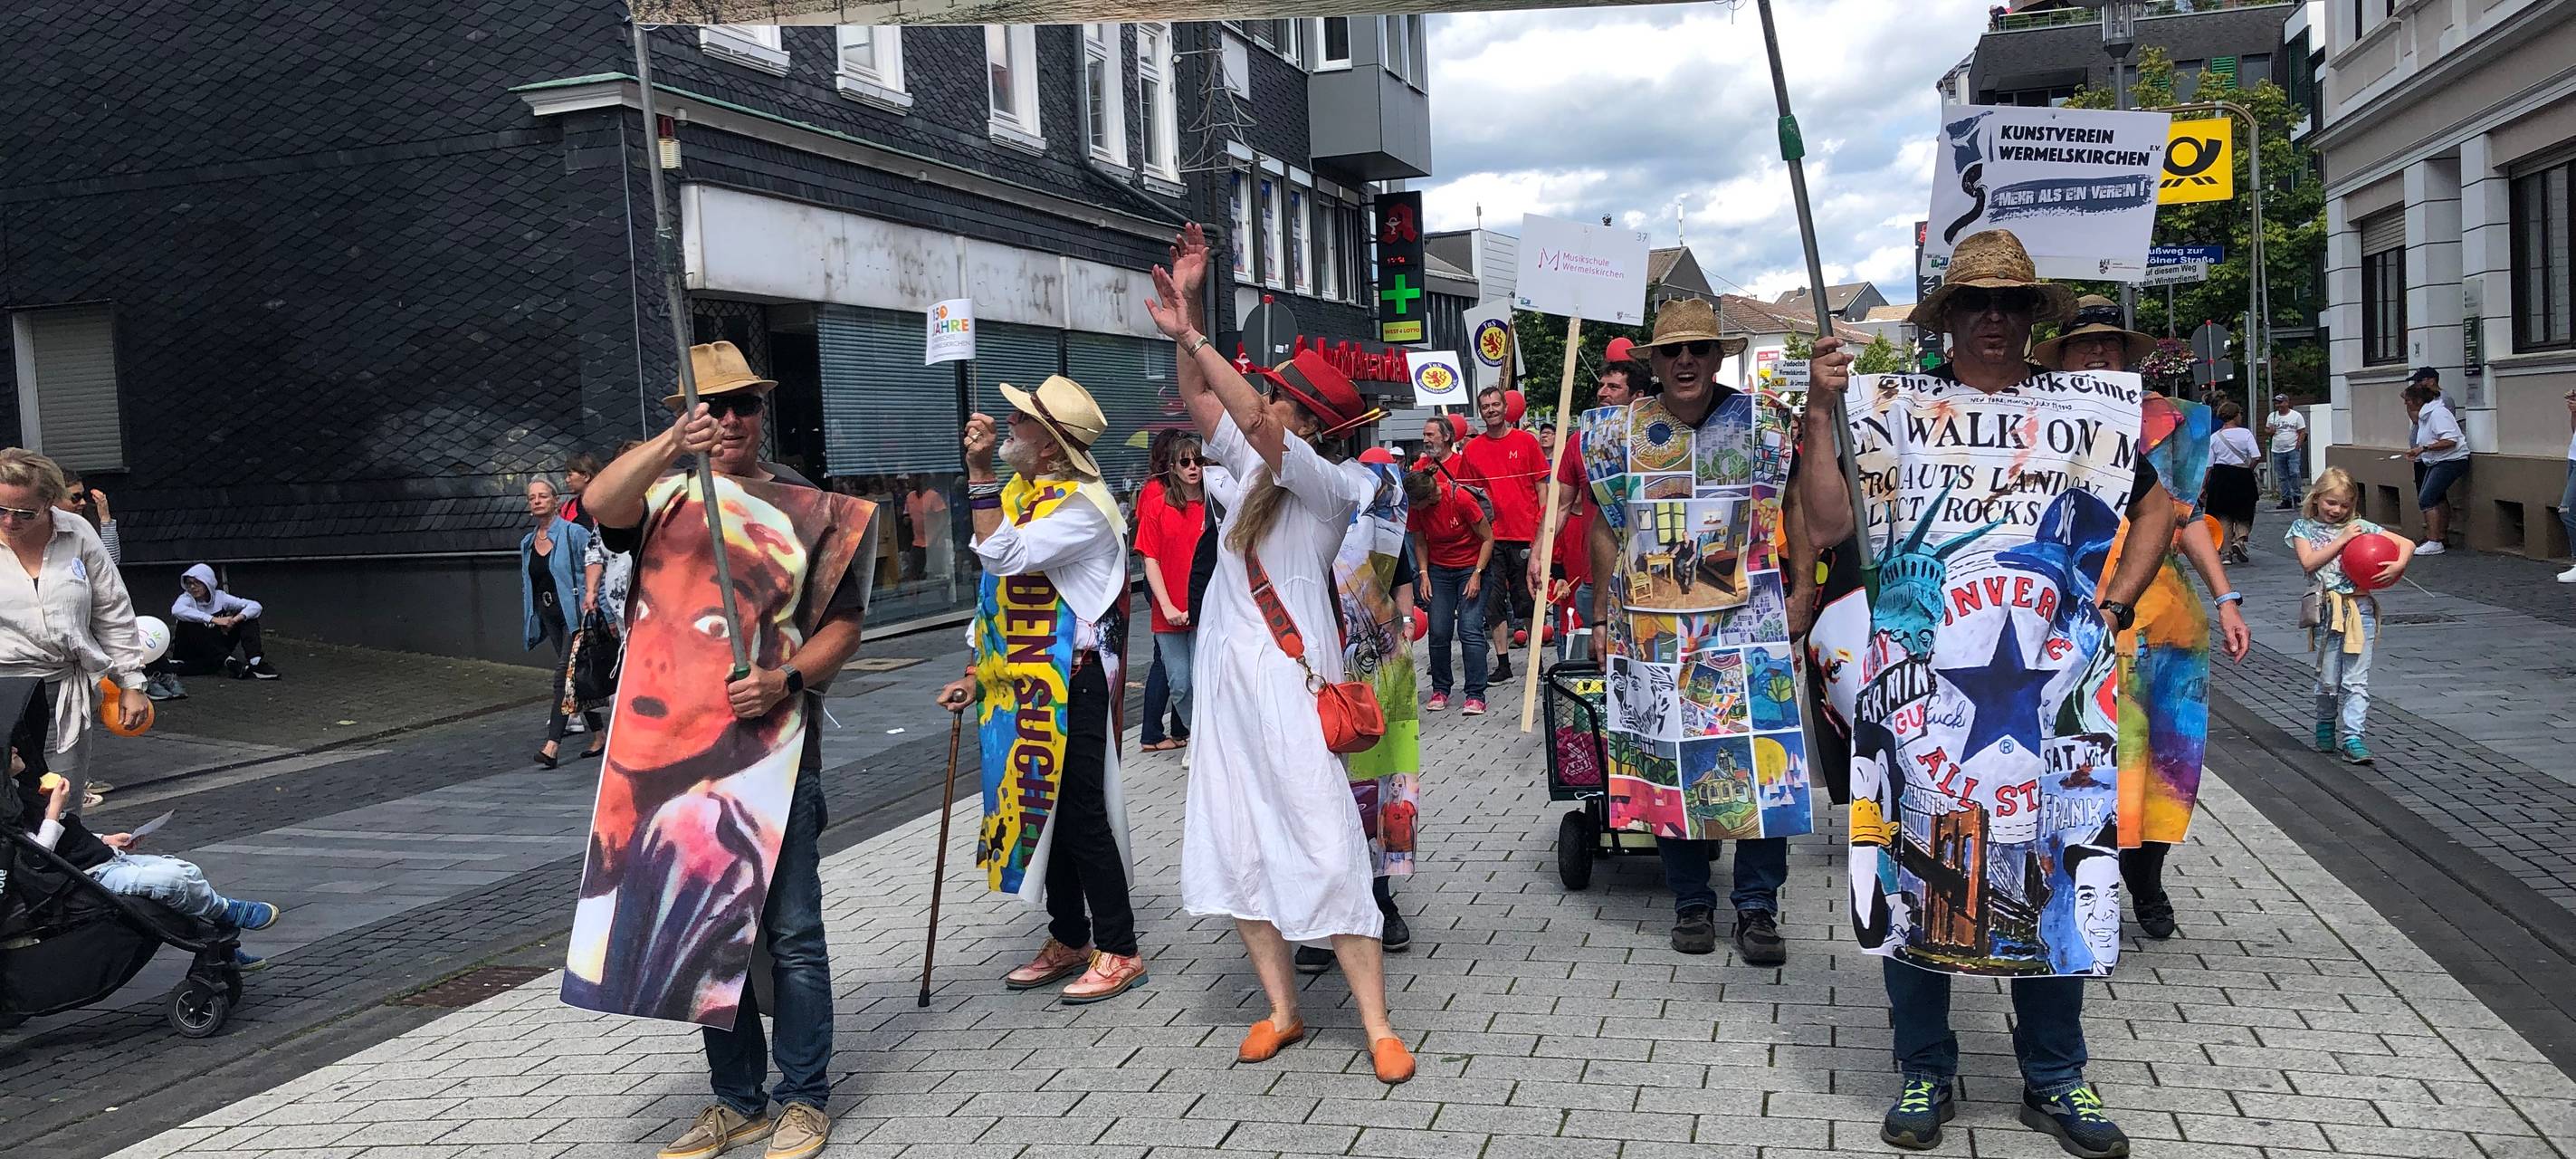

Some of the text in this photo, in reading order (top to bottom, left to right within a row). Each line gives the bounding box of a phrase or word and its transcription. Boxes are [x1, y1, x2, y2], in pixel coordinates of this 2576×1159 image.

[2000, 125, 2114, 144] KUNSTVEREIN
[1999, 145, 2151, 167] WERMELSKIRCHEN
[1999, 190, 2035, 206] MEHR
[2038, 188, 2063, 204] ALS
[2066, 187, 2087, 201] EIN
[2091, 183, 2136, 199] VEREIN
[1636, 233, 1648, 243] 37
[1562, 253, 1609, 267] Musikschule
[2148, 247, 2184, 256] ußweg
[2148, 256, 2177, 264] ölner
[1562, 263, 1625, 280] Wermelskirchen
[2154, 265, 2180, 275] diesem
[2180, 264, 2197, 273] Weg
[2154, 274, 2199, 285] Winterdienst
[932, 304, 949, 321] 150
[932, 319, 969, 337] JAHRE
[1483, 320, 1496, 329] TuS
[1877, 375, 1930, 393] The
[2070, 373, 2142, 406] Time
[1904, 408, 2028, 450] WALK
[2046, 418, 2103, 459] ON
[1989, 465, 2069, 496] LAND
[1942, 497, 2041, 526] ROCKS
[1916, 746, 1980, 810] ALL
[2041, 793, 2105, 838] FRANK
